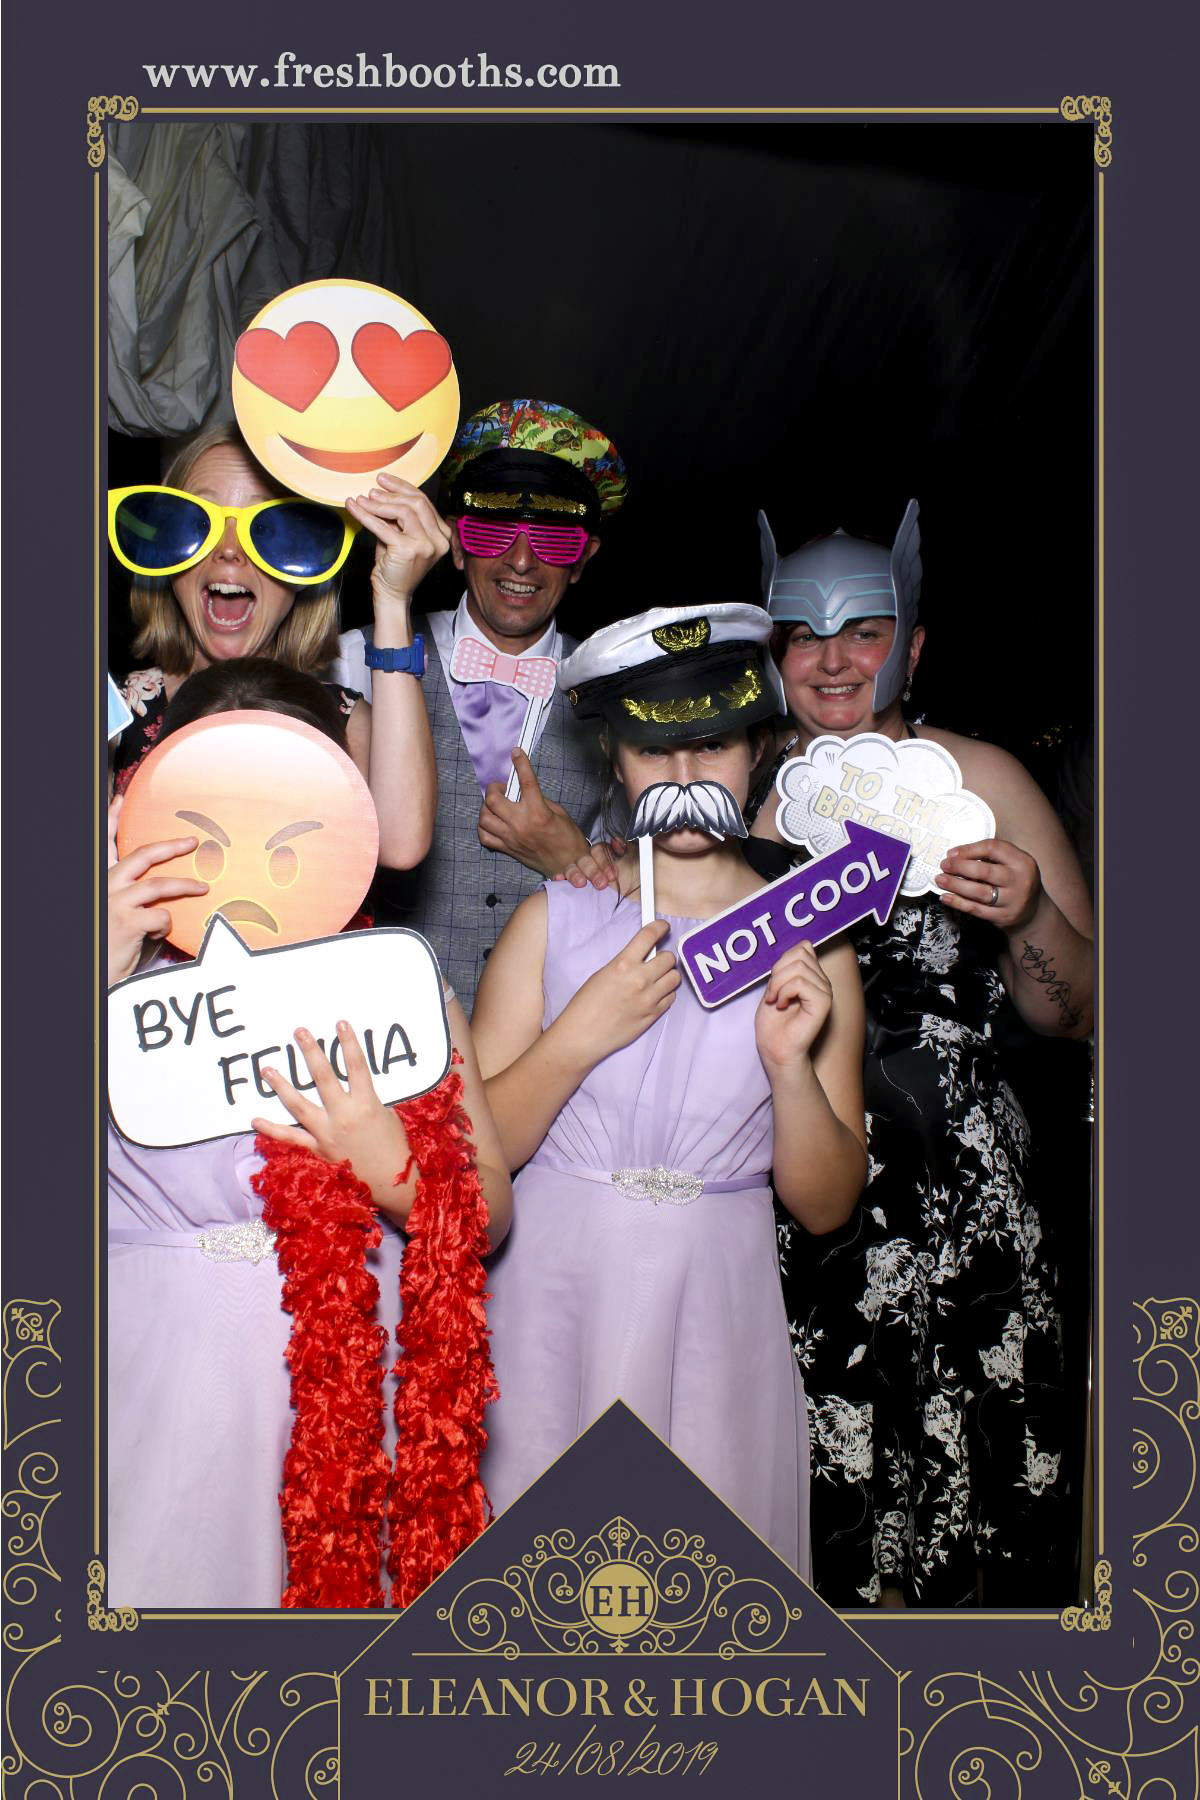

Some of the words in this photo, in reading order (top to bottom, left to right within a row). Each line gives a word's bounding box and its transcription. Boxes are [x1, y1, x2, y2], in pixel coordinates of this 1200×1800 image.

[840, 762, 883, 800] TO
[894, 785, 953, 834] THE
[693, 912, 777, 984] NOT
[784, 850, 891, 928] COOL
[133, 984, 246, 1053] BYE
